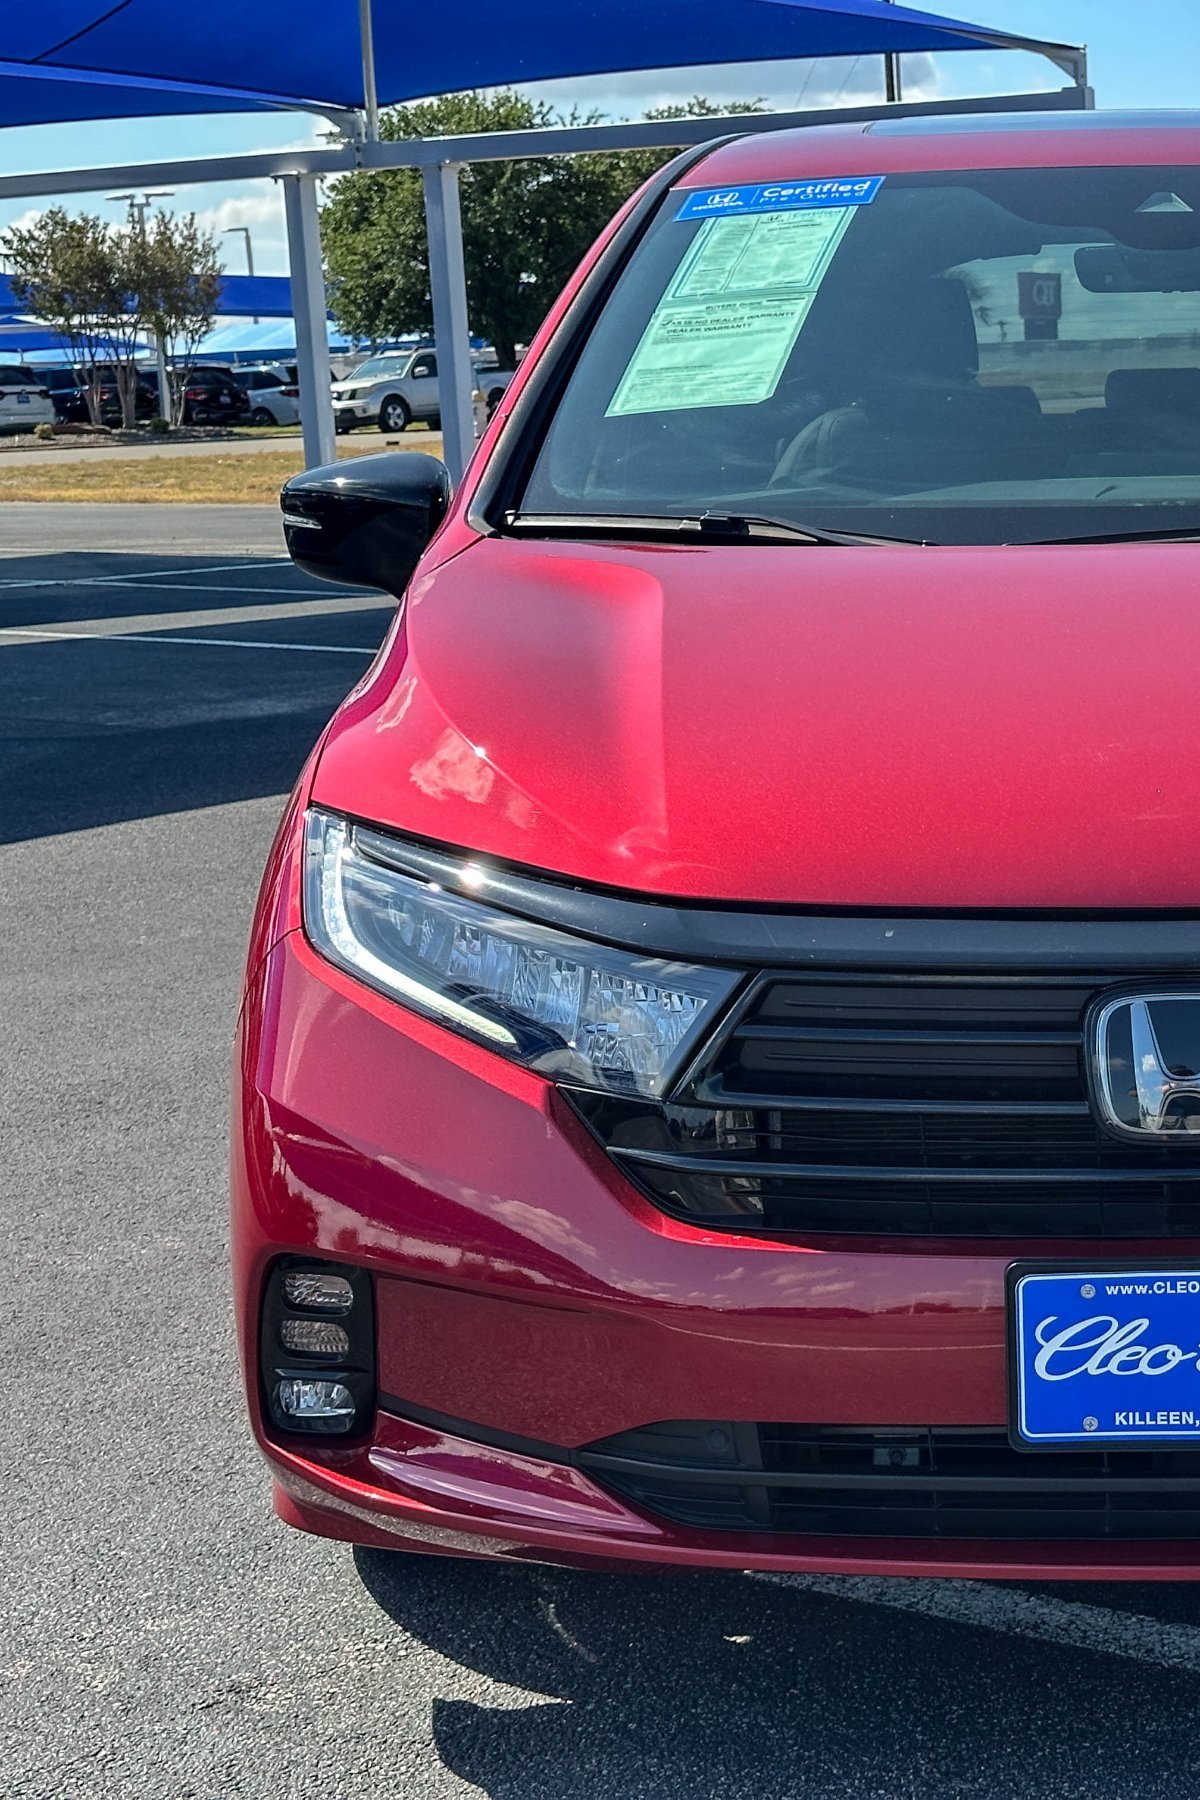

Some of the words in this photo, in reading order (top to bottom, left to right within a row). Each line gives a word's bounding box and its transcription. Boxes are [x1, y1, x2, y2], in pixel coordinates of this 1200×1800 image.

[763, 181, 871, 197] Certified
[1032, 280, 1057, 307] QT
[747, 311, 796, 320] WARRANTY
[703, 323, 752, 332] WARRANTY
[1034, 1315, 1197, 1381] Cleo
[1114, 1410, 1200, 1427] KILLEEN,
